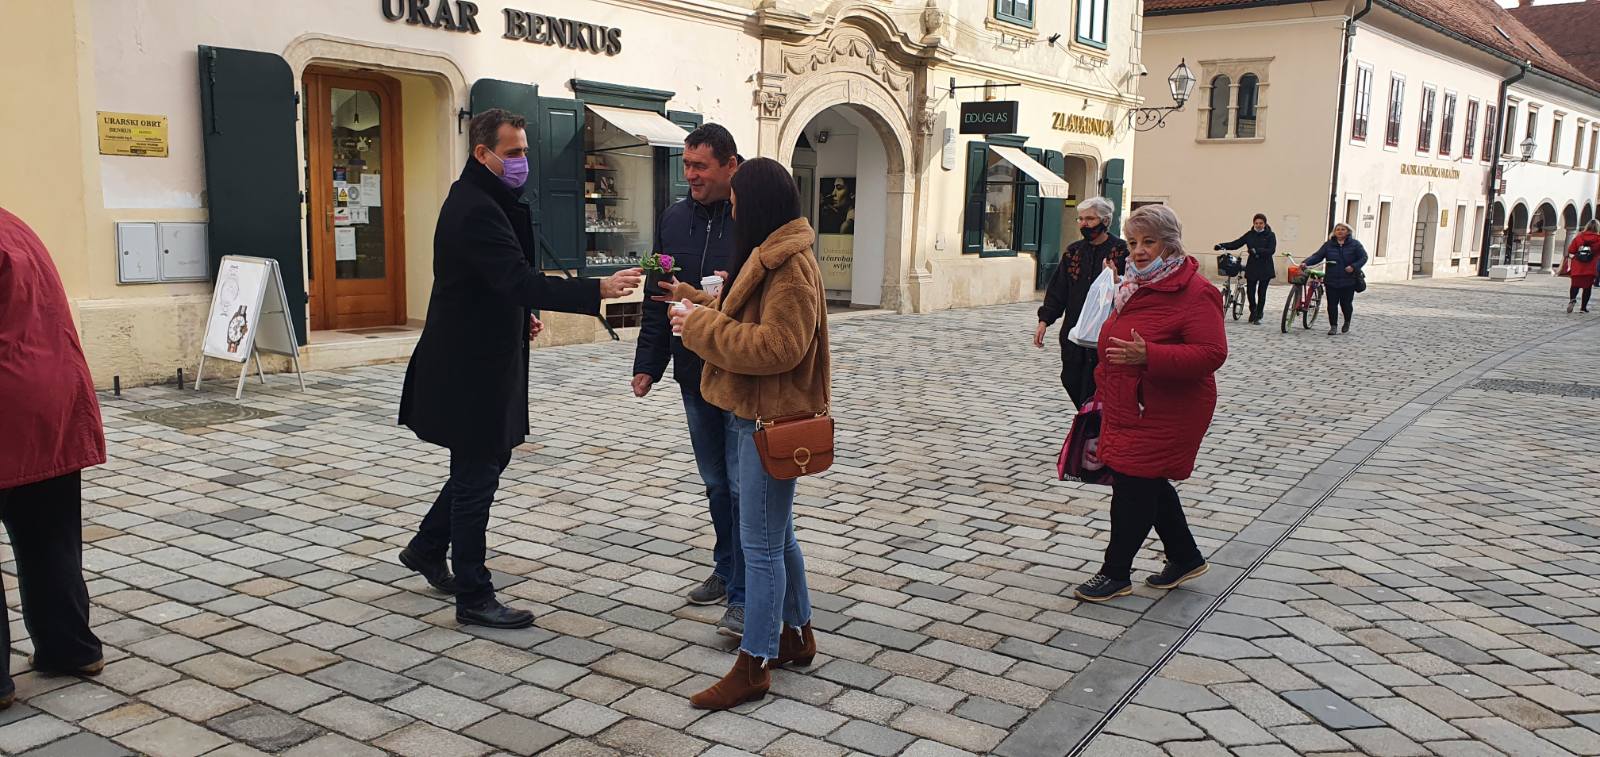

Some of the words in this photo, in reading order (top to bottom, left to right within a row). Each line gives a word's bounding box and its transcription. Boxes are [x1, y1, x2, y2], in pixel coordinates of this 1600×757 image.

[381, 0, 481, 34] URAR
[502, 8, 622, 56] BENKUS
[104, 117, 139, 127] URARSKI
[140, 120, 161, 128] OBRT
[964, 112, 1008, 124] DOUGLAS
